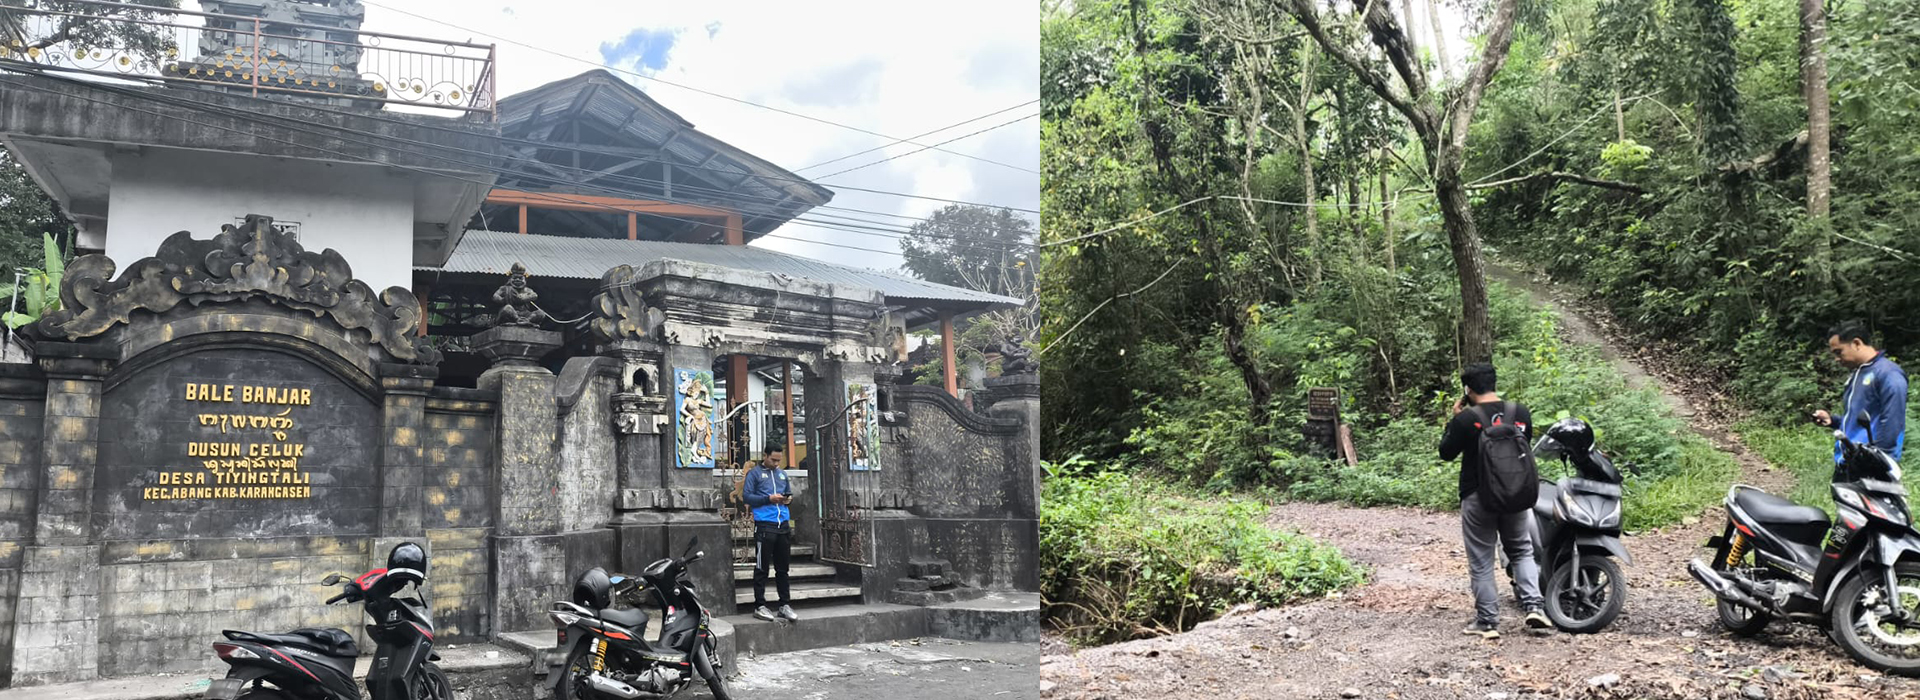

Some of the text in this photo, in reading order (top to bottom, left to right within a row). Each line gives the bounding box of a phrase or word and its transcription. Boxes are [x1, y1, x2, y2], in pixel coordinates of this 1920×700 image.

[185, 383, 311, 406] BALE BANJAR
[187, 442, 304, 457] DUSUN CELUK
[159, 472, 310, 485] DESA TIYINGTALI
